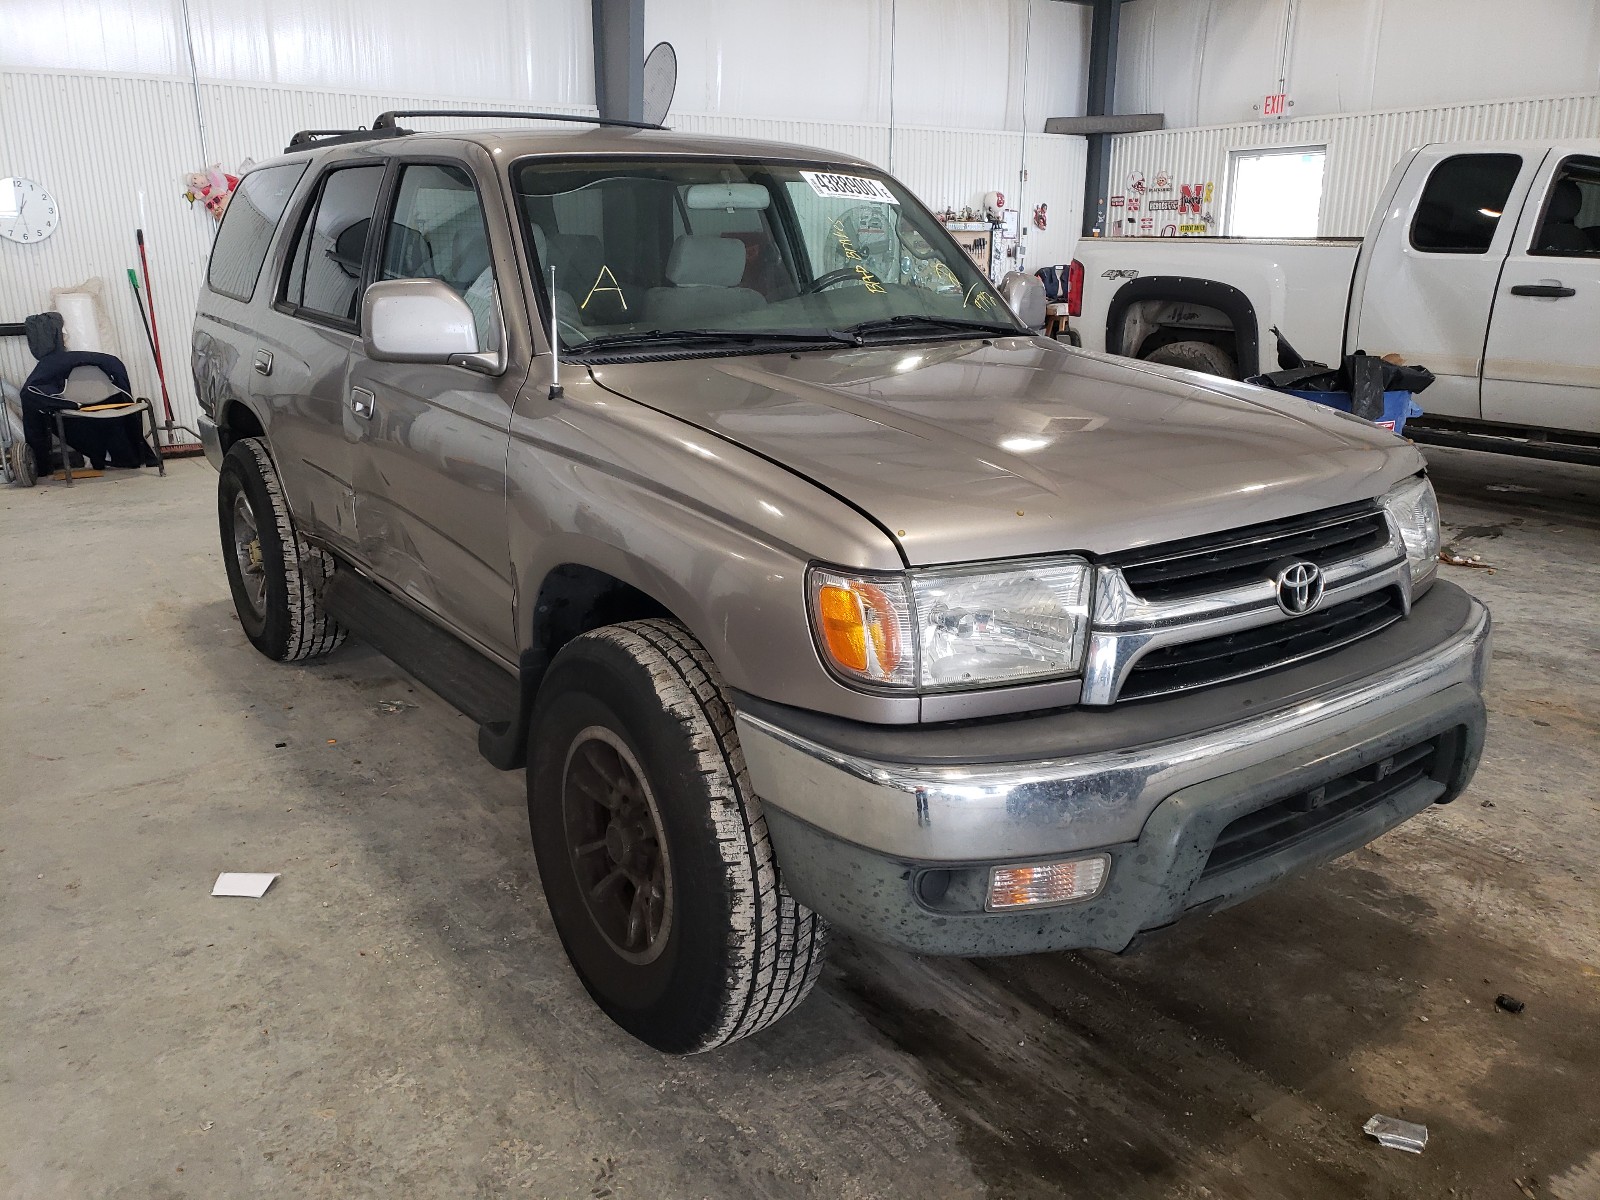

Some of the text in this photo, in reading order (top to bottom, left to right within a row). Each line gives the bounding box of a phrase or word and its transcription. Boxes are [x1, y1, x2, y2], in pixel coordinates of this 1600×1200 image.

[1264, 94, 1286, 114] EXIT
[814, 173, 882, 197] 43889001
[581, 265, 628, 310] A
